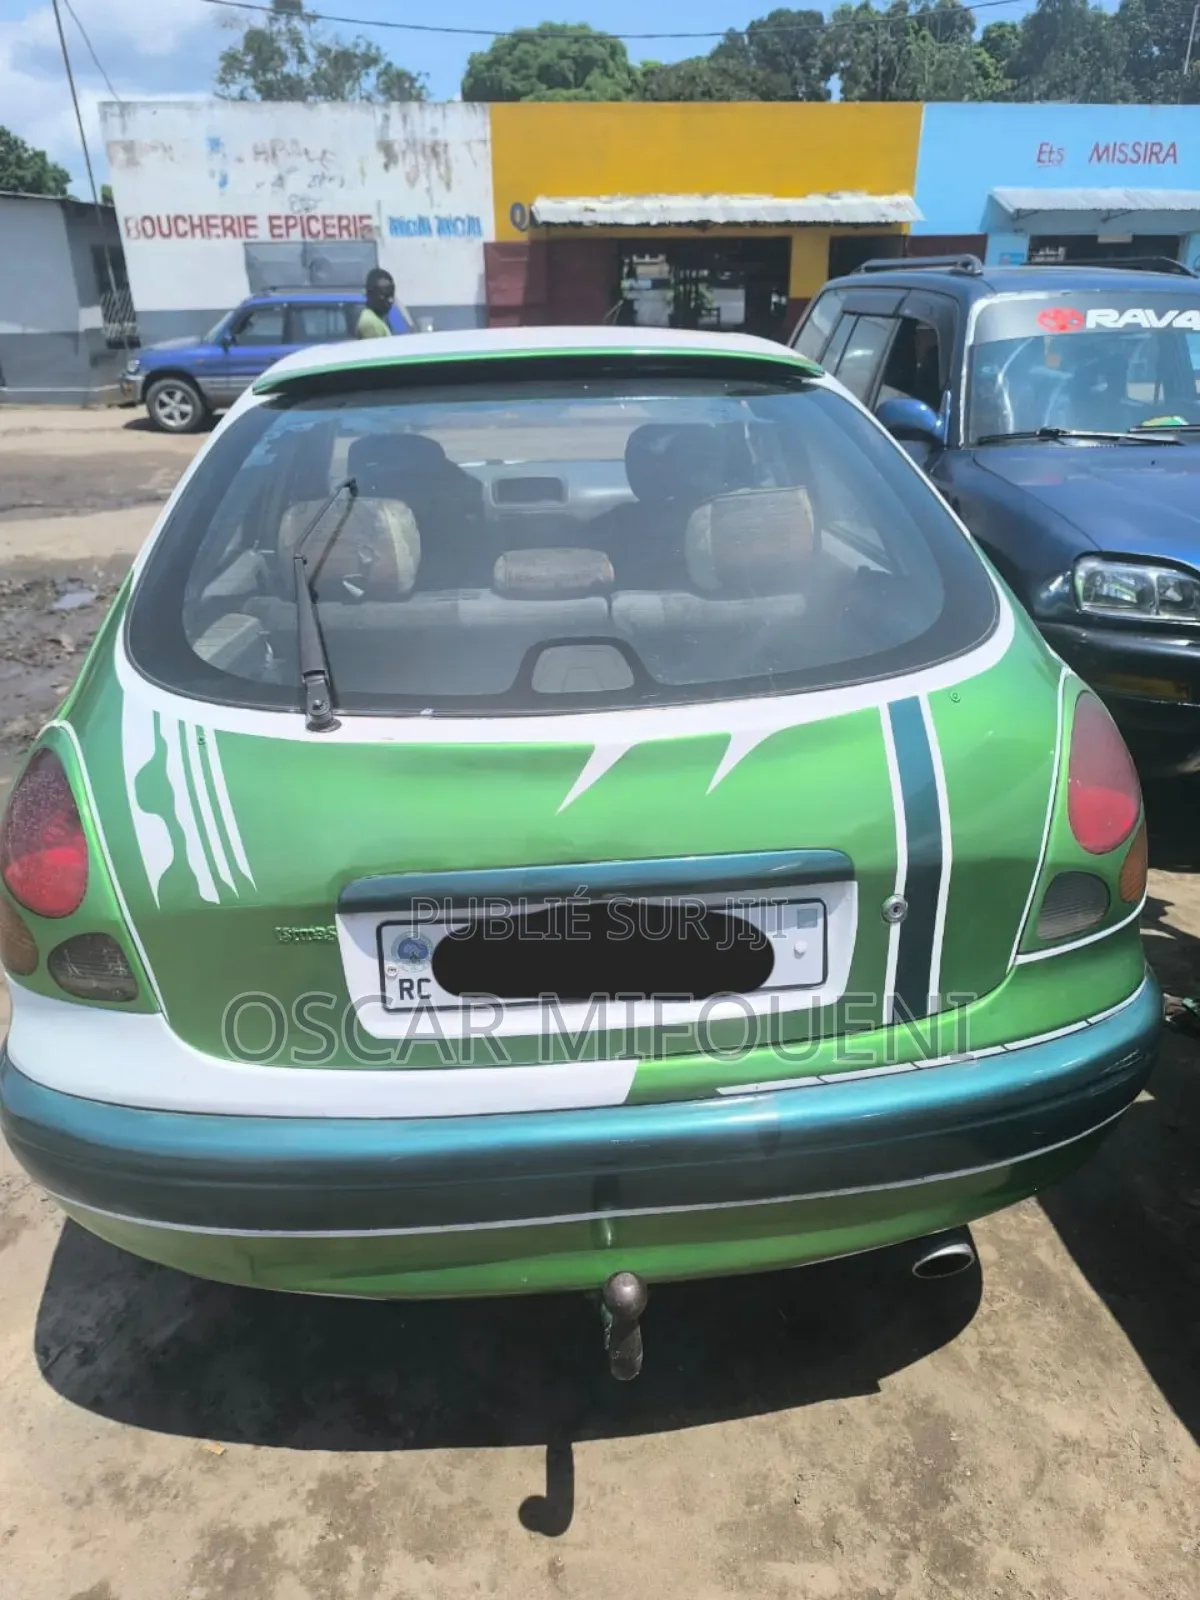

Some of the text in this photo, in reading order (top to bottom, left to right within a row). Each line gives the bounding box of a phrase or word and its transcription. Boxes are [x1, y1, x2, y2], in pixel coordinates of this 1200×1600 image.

[1087, 141, 1179, 165] MISSIRA
[267, 213, 373, 240] EPICERIE
[1085, 308, 1200, 331] RAV4
[398, 977, 432, 1001] RC
